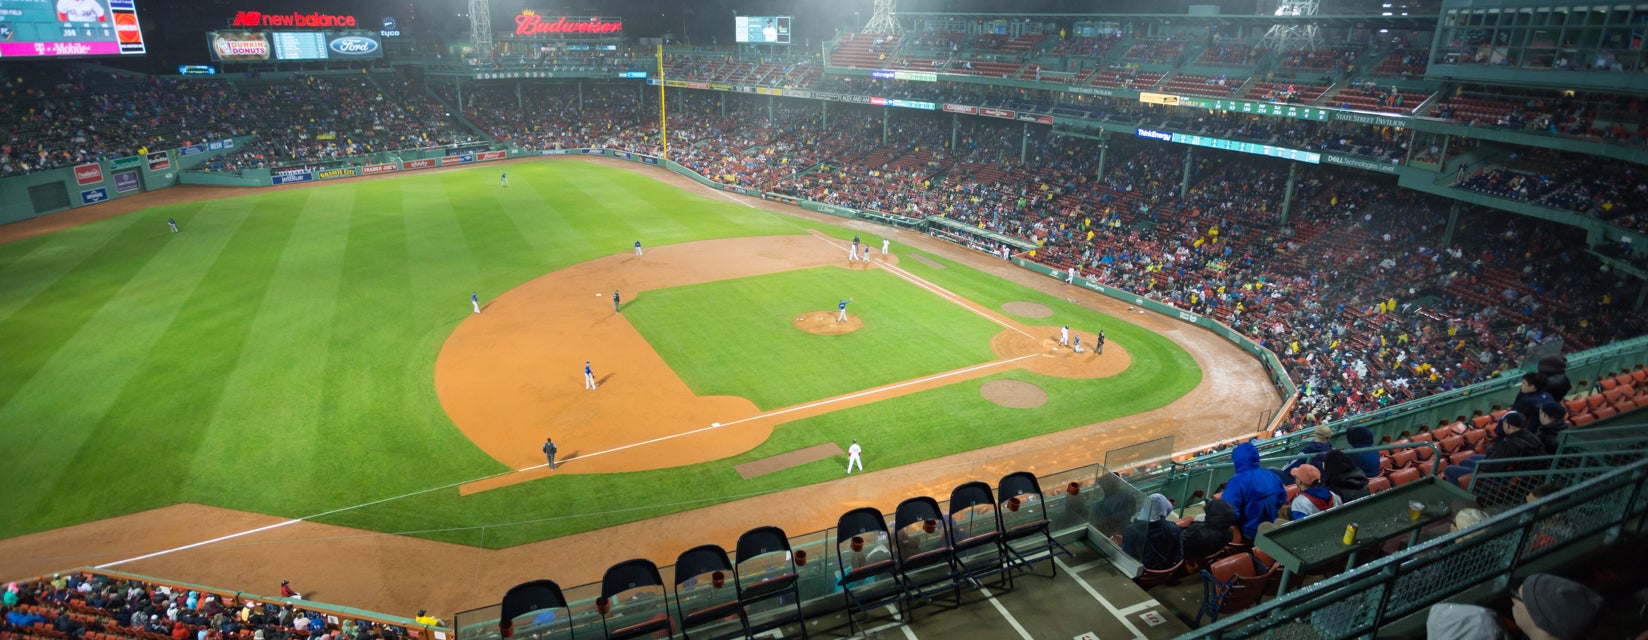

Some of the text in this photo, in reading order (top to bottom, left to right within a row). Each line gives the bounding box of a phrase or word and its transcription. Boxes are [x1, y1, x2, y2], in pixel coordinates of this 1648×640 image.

[262, 15, 293, 26] new
[294, 12, 356, 26] balance
[515, 15, 622, 35] Budweiser
[340, 40, 368, 51] Ford
[1354, 115, 1374, 124] STREET
[1375, 117, 1406, 127] PAVILION
[1138, 128, 1172, 141] ThinkEnergy
